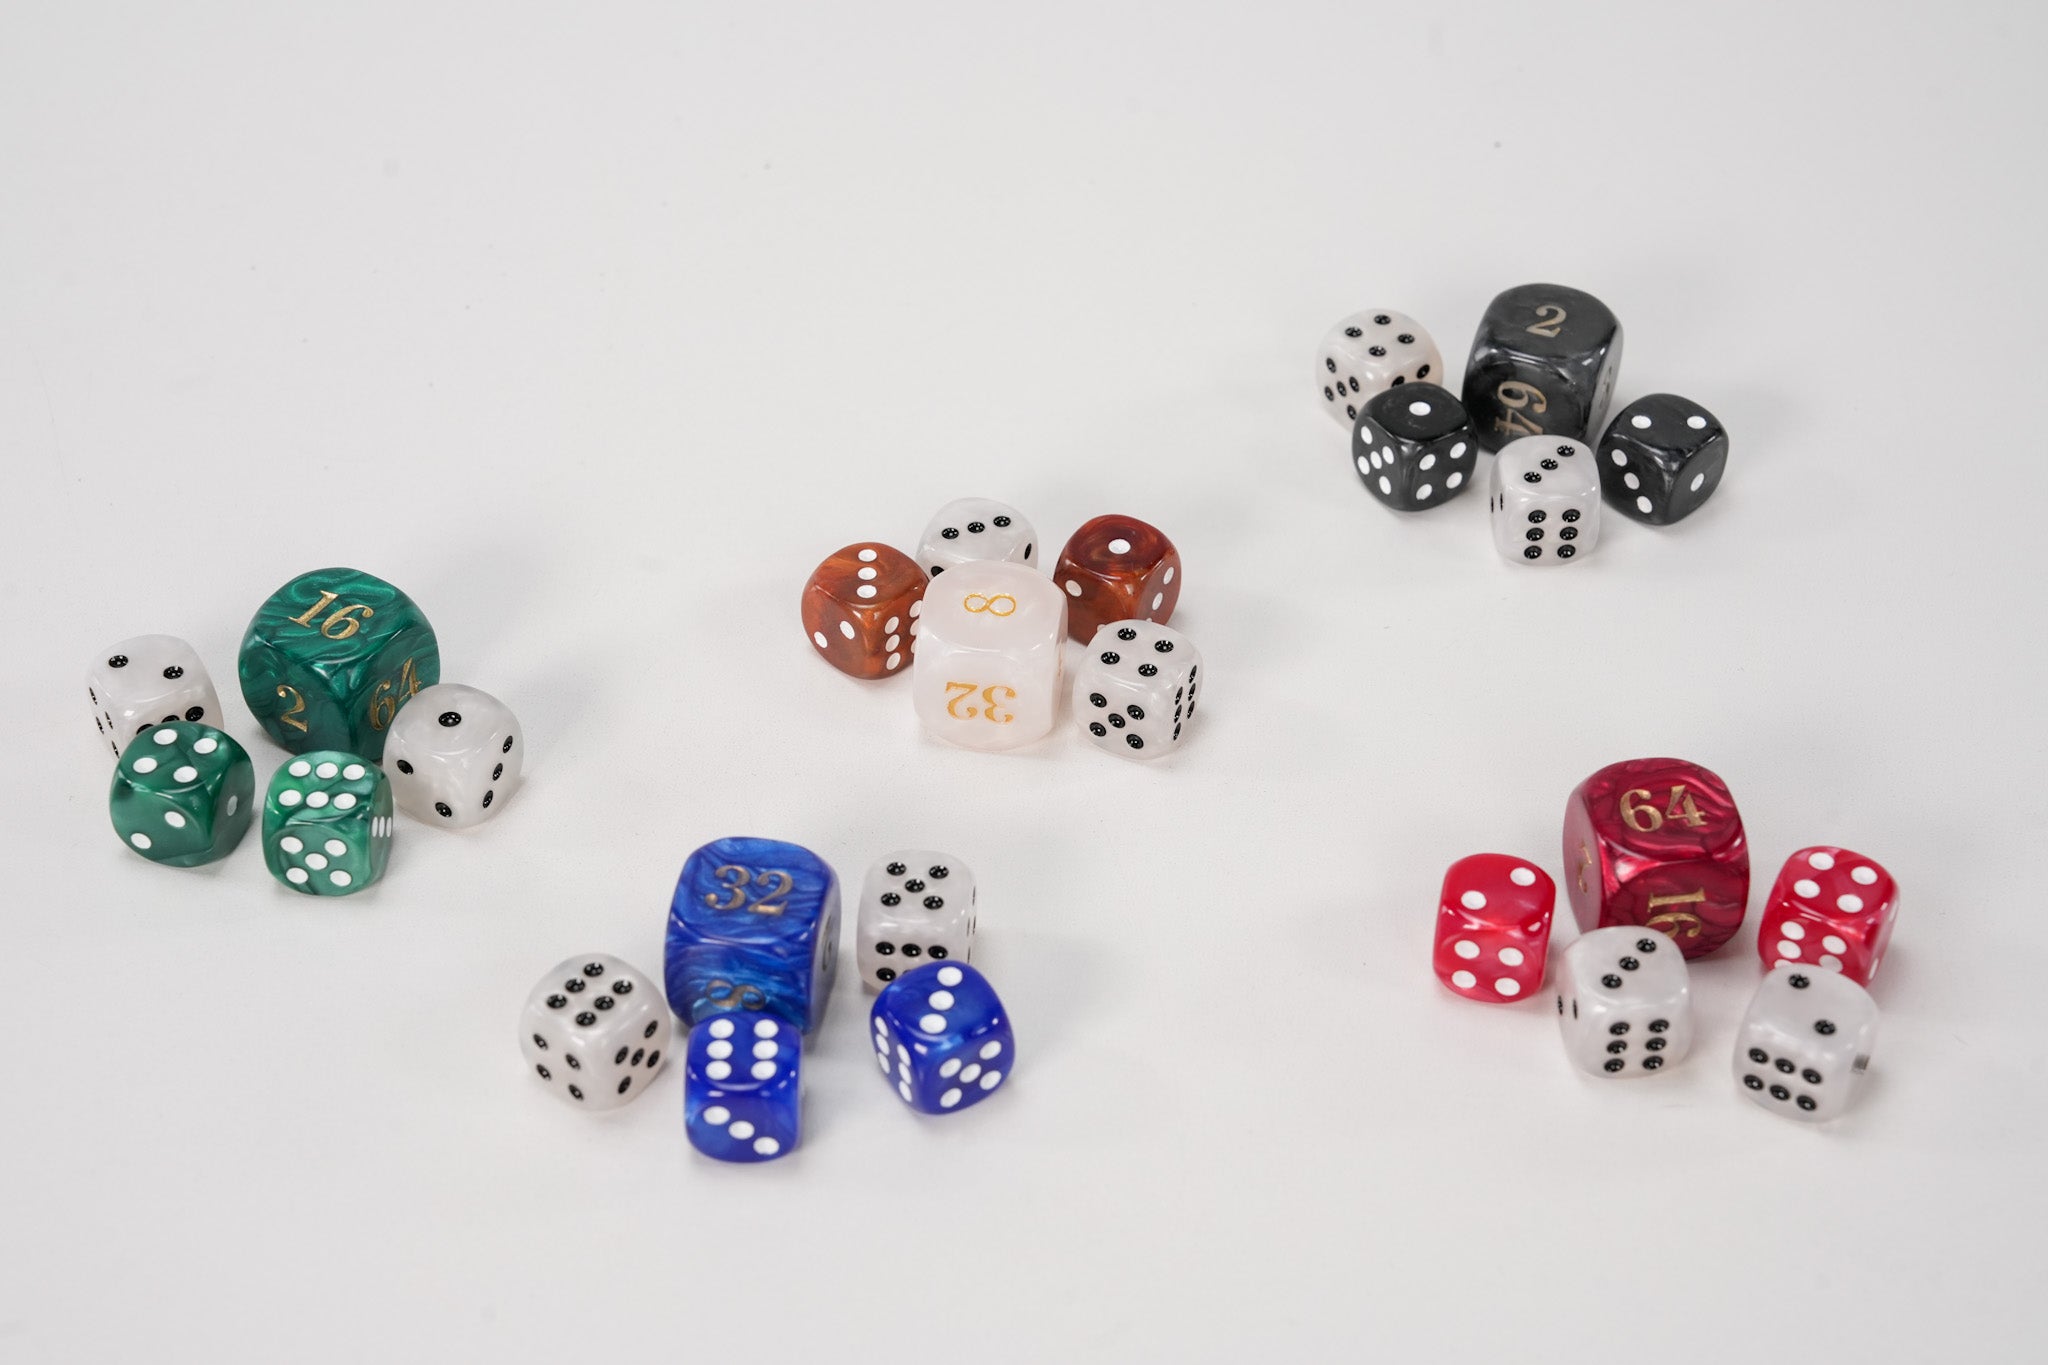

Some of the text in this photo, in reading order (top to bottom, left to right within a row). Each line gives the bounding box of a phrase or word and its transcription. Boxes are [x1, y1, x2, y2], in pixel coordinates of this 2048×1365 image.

[1525, 304, 1567, 338] 2
[1494, 380, 1547, 436] 64
[287, 590, 374, 640] 16
[276, 684, 308, 733] 2
[370, 657, 422, 731] 64
[945, 681, 1017, 724] 32
[1619, 784, 1708, 833] 64
[705, 864, 794, 916] 32
[706, 979, 767, 1011] 8
